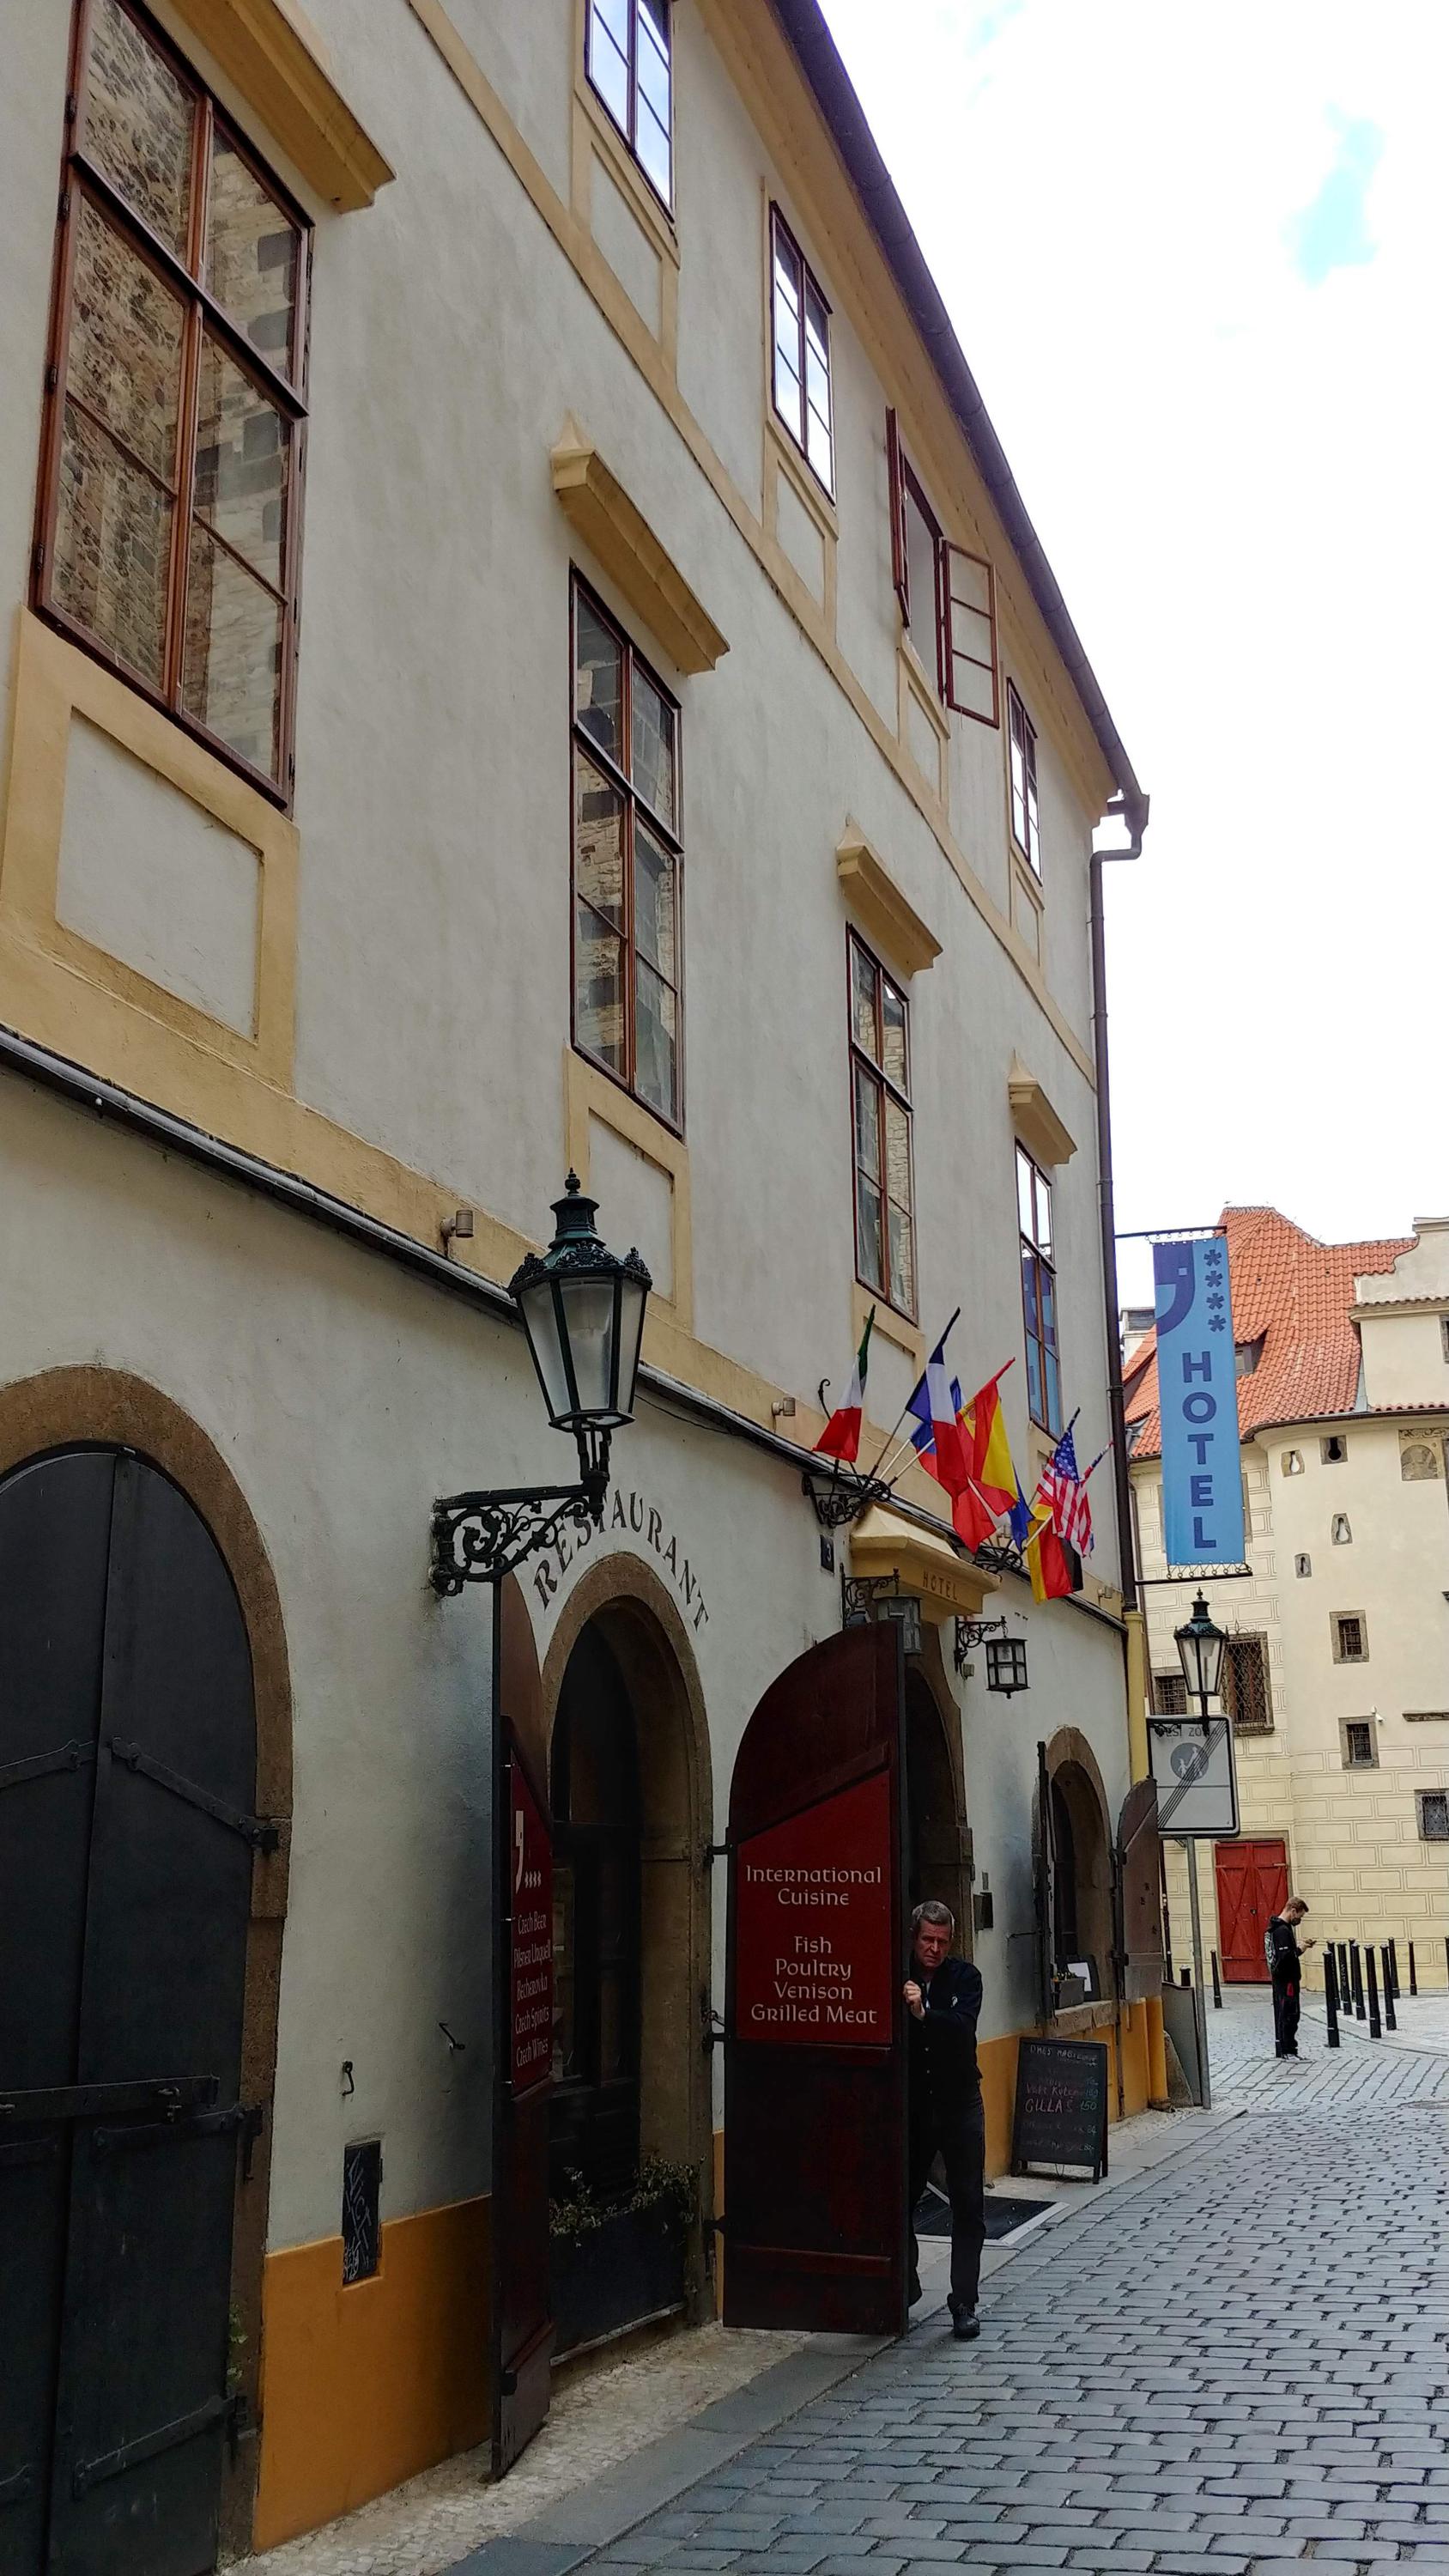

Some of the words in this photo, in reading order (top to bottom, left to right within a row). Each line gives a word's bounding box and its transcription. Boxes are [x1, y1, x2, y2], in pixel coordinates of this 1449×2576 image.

[1181, 1350, 1217, 1549] HOTEL
[922, 1571, 958, 1601] HOTEL
[745, 1864, 882, 1884] International
[777, 1888, 850, 1906] Cuisine
[518, 1914, 533, 1935] Czech
[533, 1910, 547, 1932] Beer
[513, 1946, 531, 1969] Pilsner
[531, 1939, 551, 1965] Urquell
[794, 1935, 833, 1955] Fish
[775, 1959, 852, 1981] Poultry
[517, 1971, 549, 2002] Becherovka
[774, 1981, 853, 2001] Venison
[514, 2010, 530, 2035] Czech
[530, 2003, 550, 2029] Spirits
[751, 2003, 820, 2023] Grilled
[826, 2005, 878, 2025] Meat
[515, 2044, 532, 2069] Czech
[531, 2037, 549, 2061] Wines
